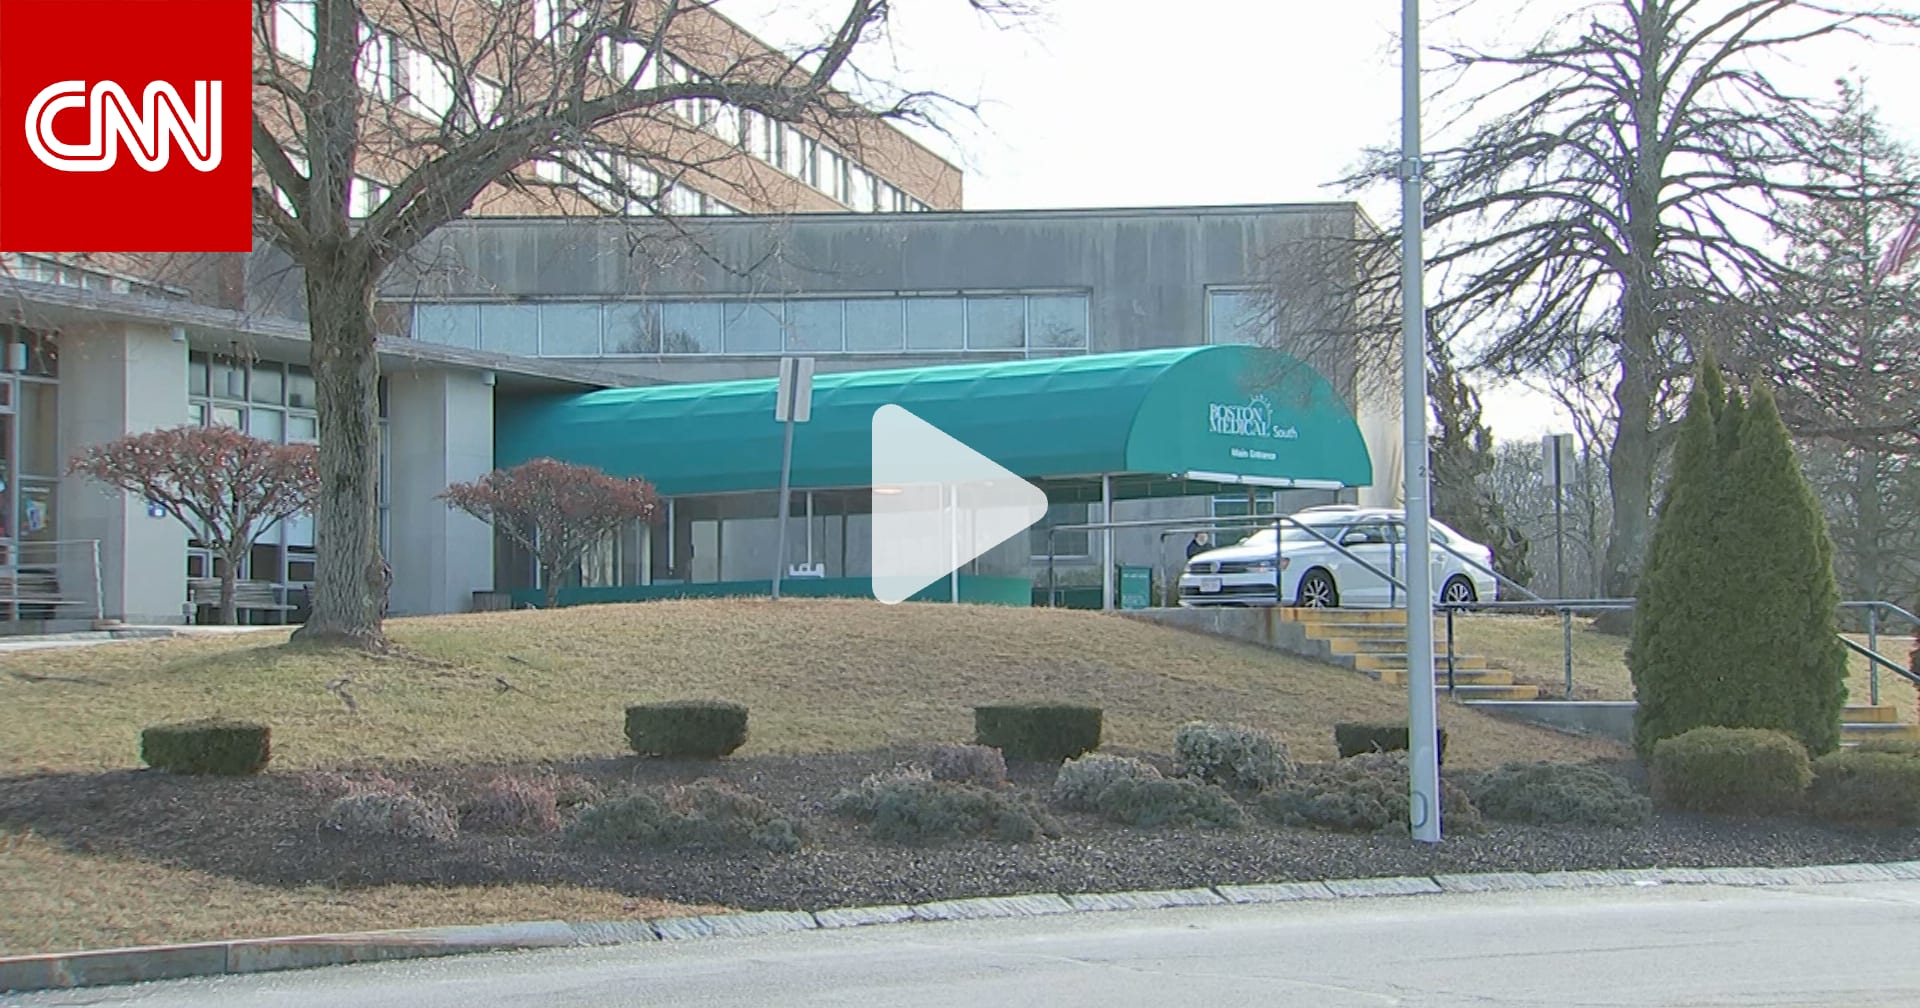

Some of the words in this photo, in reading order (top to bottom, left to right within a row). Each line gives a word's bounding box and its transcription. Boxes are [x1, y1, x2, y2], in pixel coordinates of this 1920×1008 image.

[1209, 403, 1263, 421] BOSTON
[1209, 418, 1270, 436] MEDICAL
[1272, 425, 1298, 438] South
[1231, 447, 1249, 458] Main
